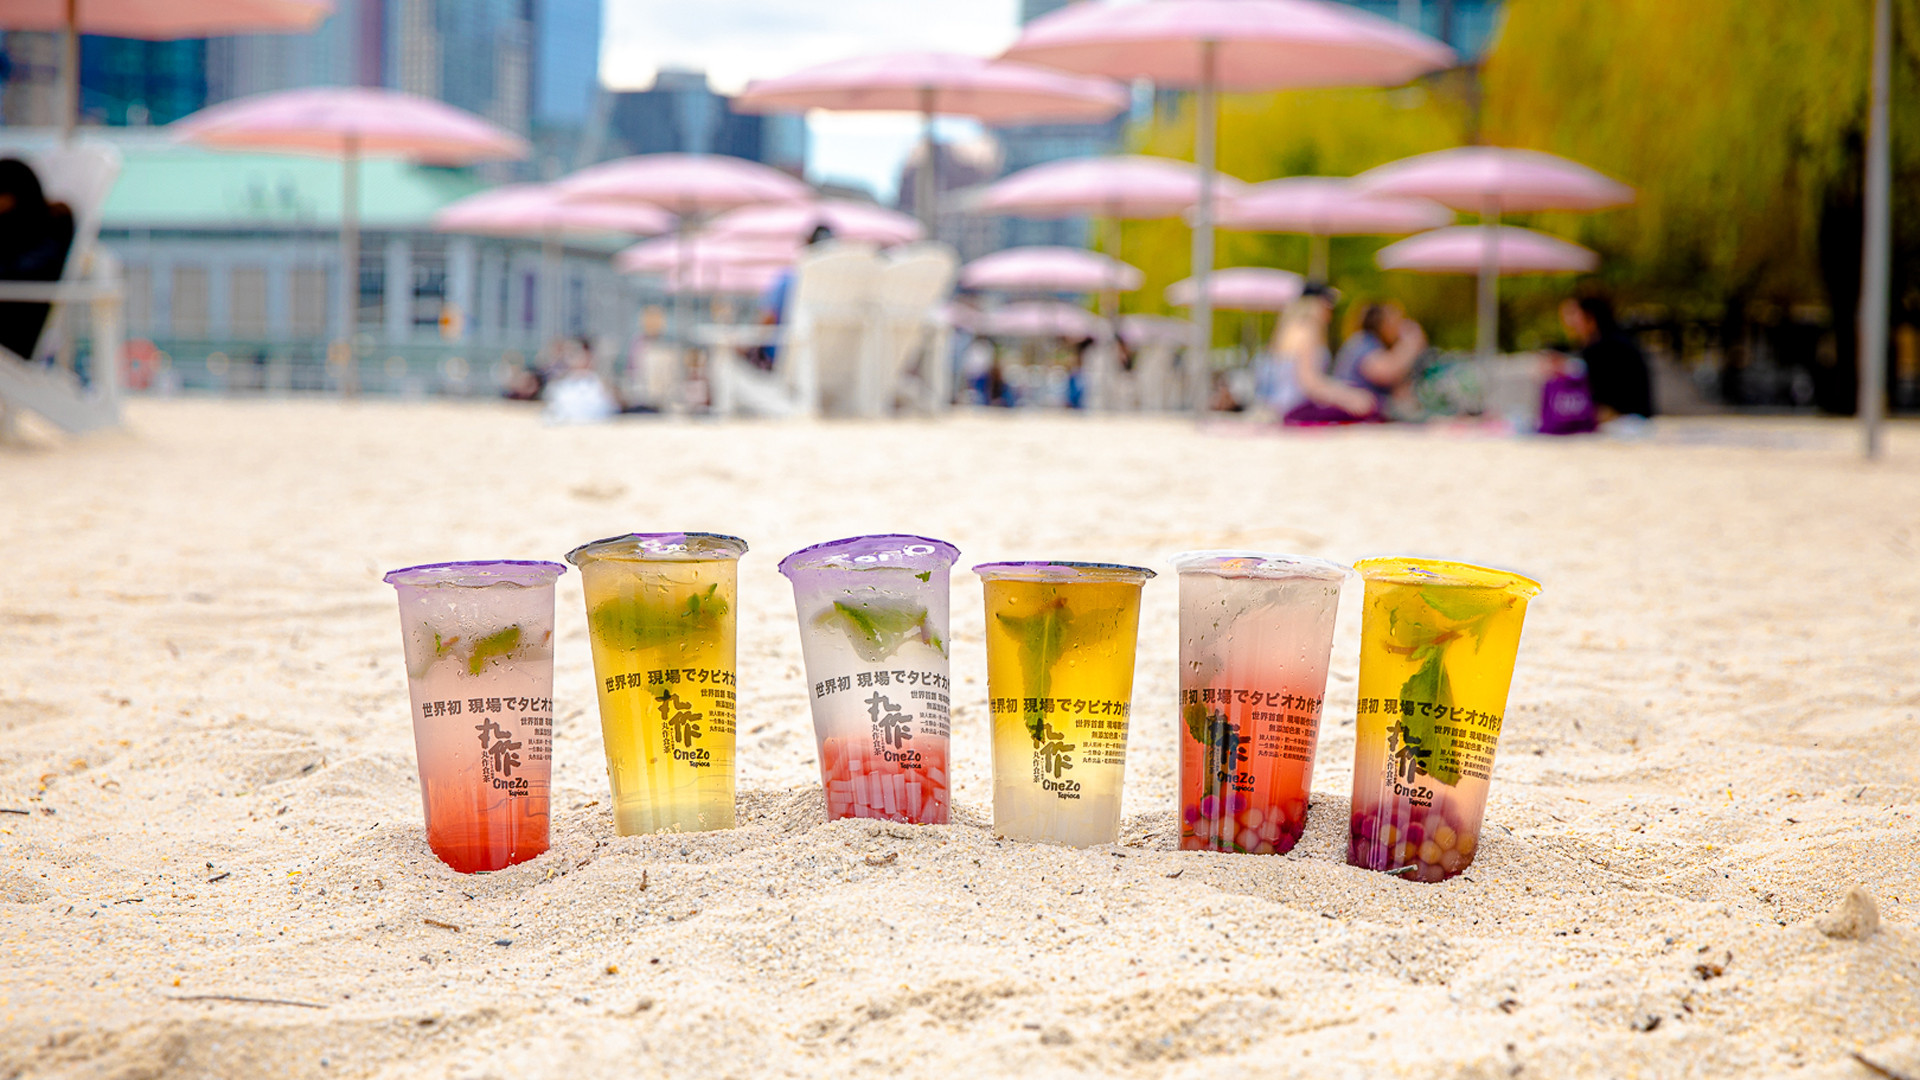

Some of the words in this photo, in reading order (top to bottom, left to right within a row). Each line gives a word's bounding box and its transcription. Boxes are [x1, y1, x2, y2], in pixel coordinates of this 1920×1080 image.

[605, 673, 641, 693] 世界初
[815, 676, 851, 698] 世界初
[422, 700, 462, 718] 世界初
[674, 748, 710, 760] OneZo
[884, 750, 921, 762] OneZo
[690, 760, 710, 768] Tapioca
[493, 778, 529, 789] OneZo
[1217, 771, 1256, 784] OneZo
[1042, 779, 1081, 792] OneZo
[1232, 784, 1254, 792] Tapioca
[1394, 783, 1434, 800] OneZo
[1058, 792, 1080, 800] Tapioca
[1408, 798, 1432, 808] Tapioca
